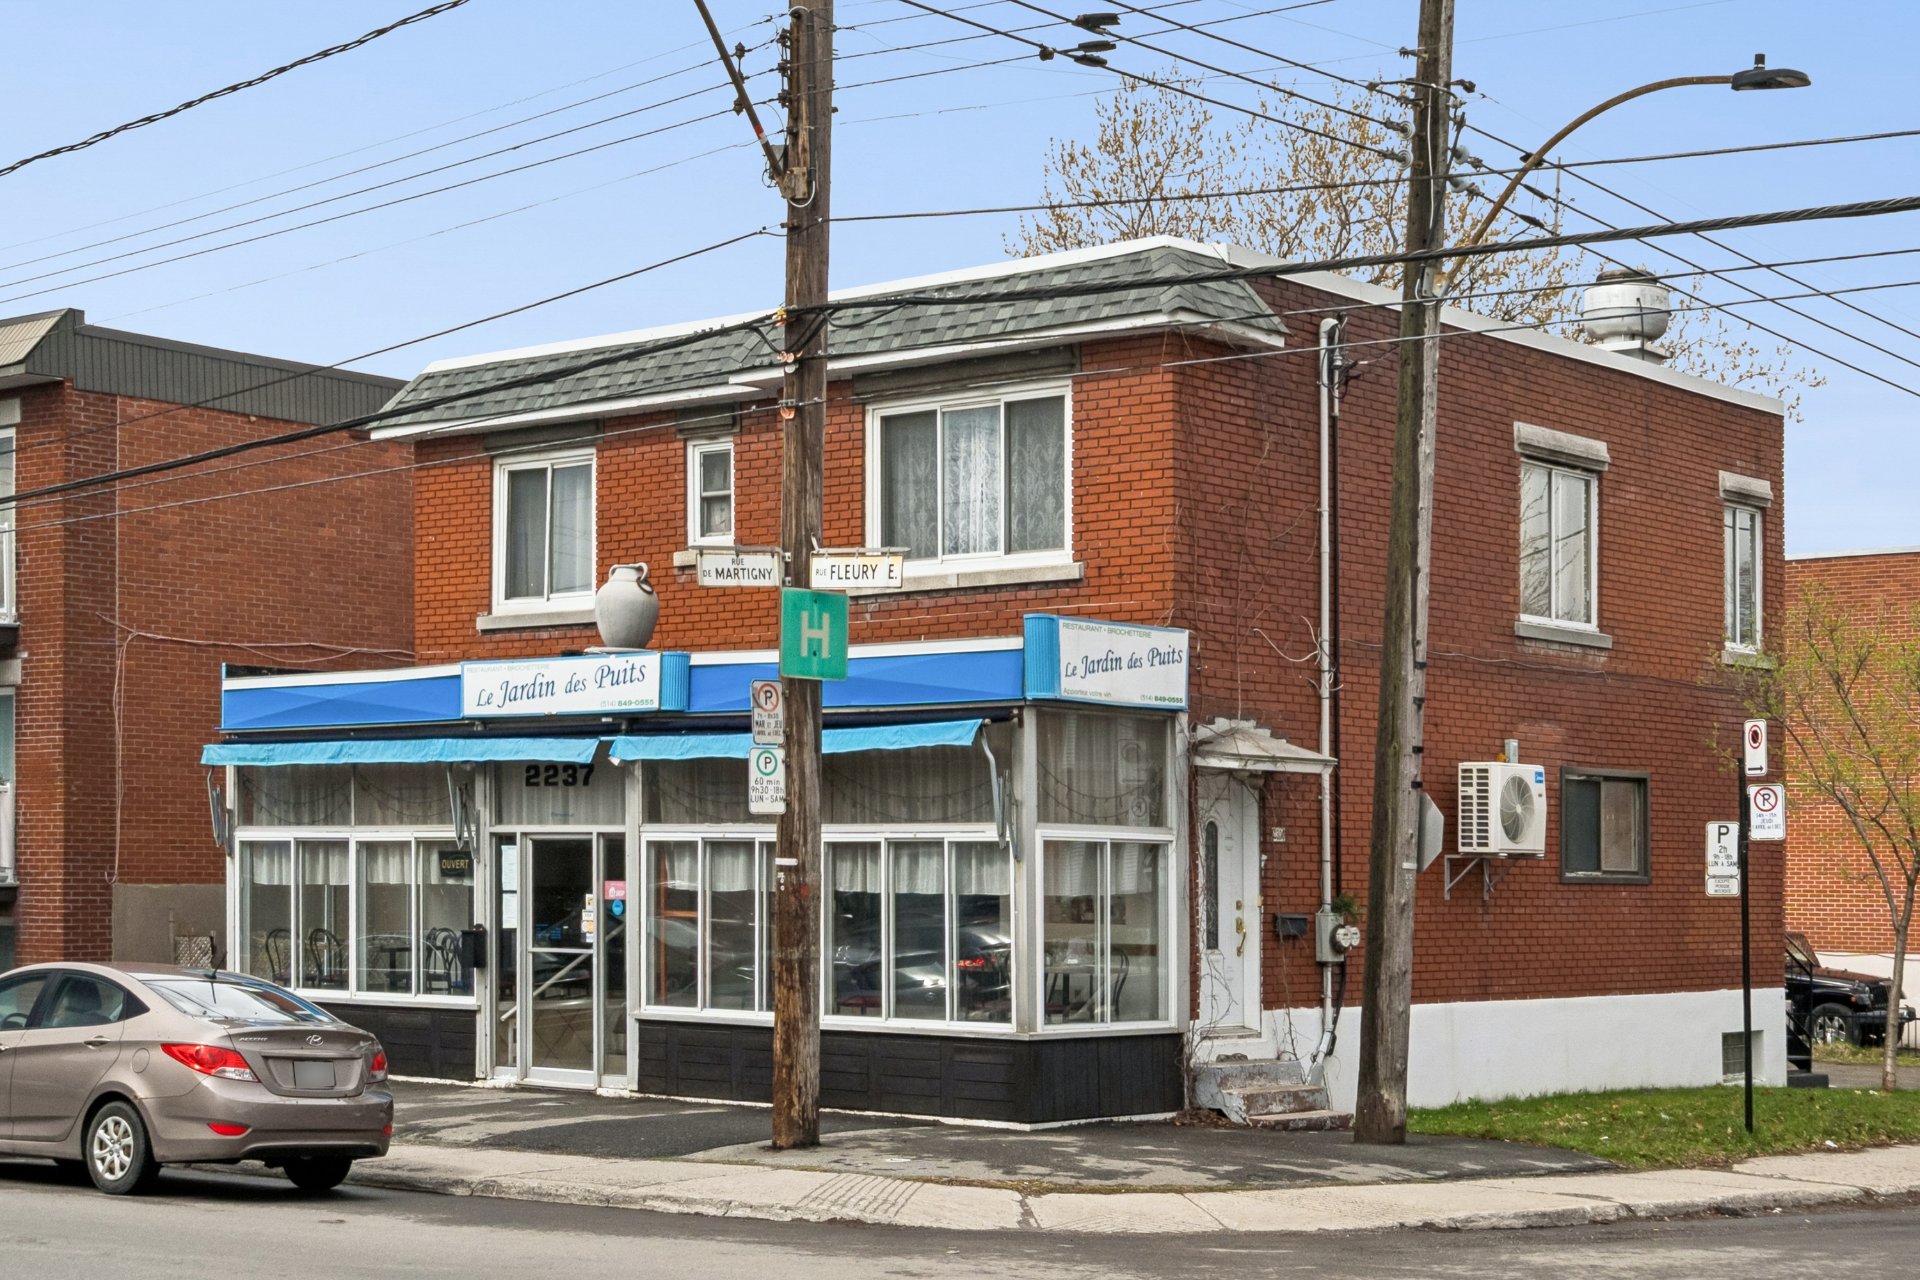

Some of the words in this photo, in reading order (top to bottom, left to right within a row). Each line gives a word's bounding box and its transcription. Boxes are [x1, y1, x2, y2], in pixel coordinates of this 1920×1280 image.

[716, 568, 772, 580] MARTIGNY
[830, 564, 878, 580] FLEURY
[800, 611, 830, 658] H
[1062, 622, 1102, 633] RESTAURANT
[1107, 627, 1152, 638] BROCHETTERIE
[1065, 662, 1077, 678] Le
[1080, 650, 1122, 679] Jardin
[1128, 652, 1143, 669] des
[1148, 645, 1183, 666] Puits
[476, 689, 494, 707] Le
[497, 672, 556, 708] Jardin
[564, 672, 587, 694] des
[594, 660, 646, 688] Puits
[525, 764, 594, 787] 2237
[750, 795, 764, 803] LUN
[771, 795, 784, 803] SAM
[1718, 825, 1729, 844] P
[442, 859, 469, 870] OUVERT
